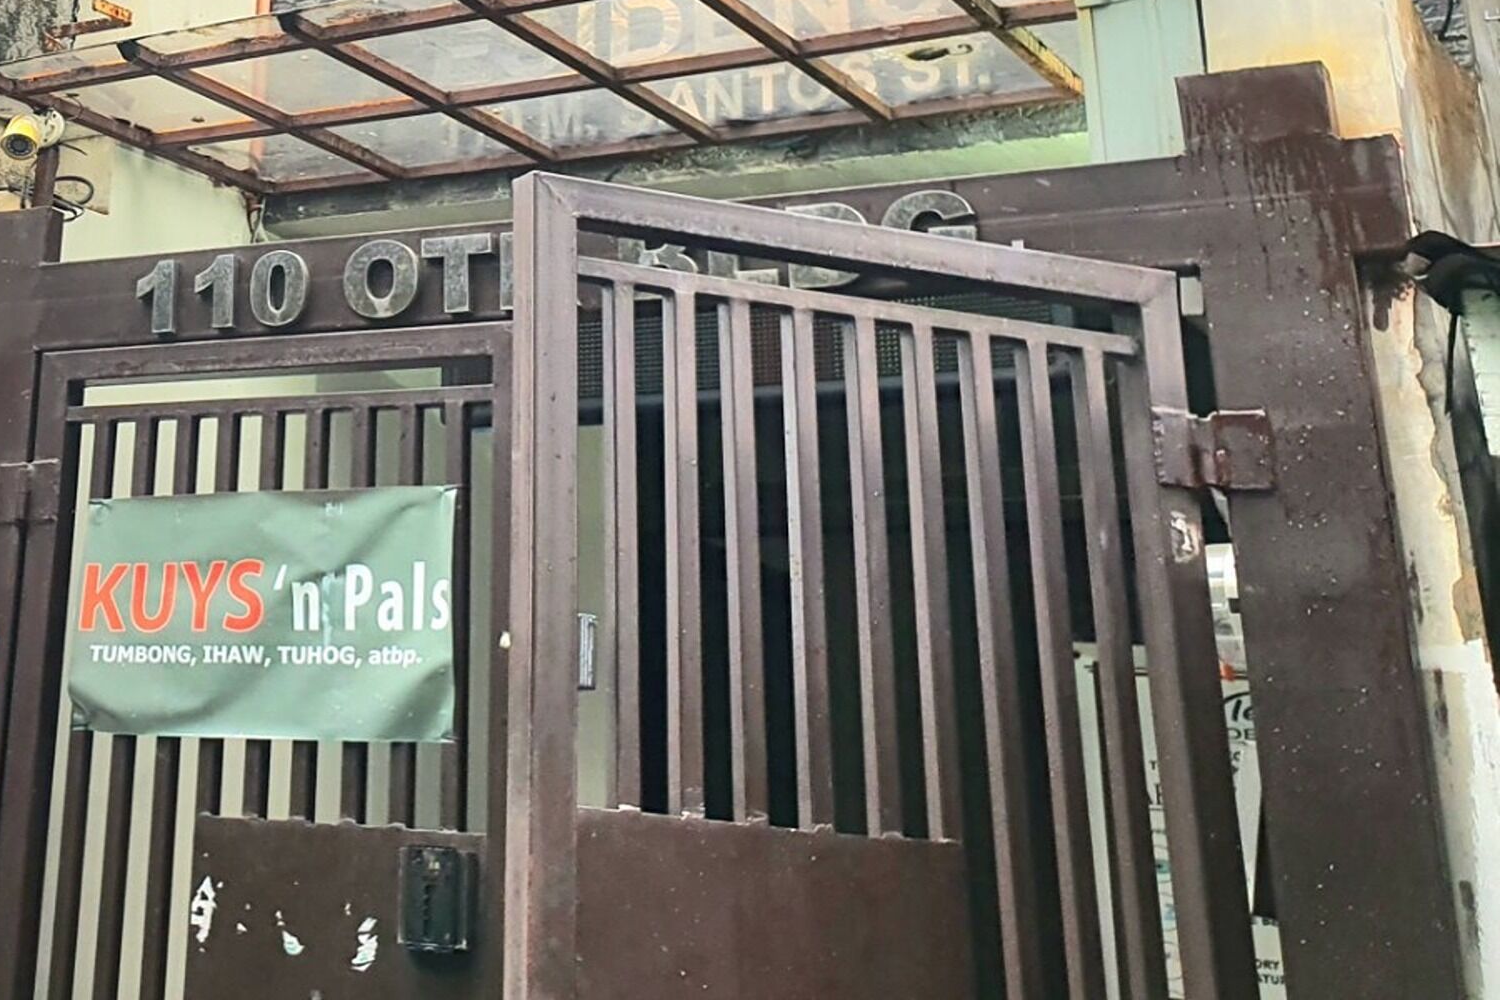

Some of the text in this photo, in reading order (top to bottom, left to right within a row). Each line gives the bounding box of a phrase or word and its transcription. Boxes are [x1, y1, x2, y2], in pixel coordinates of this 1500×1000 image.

[136, 249, 309, 336] 110
[343, 231, 514, 320] OT
[77, 557, 265, 634] KUYS
[344, 562, 450, 632] Pals
[89, 643, 423, 669] TUMBONG, IHAW, TUHOG, atbp.
